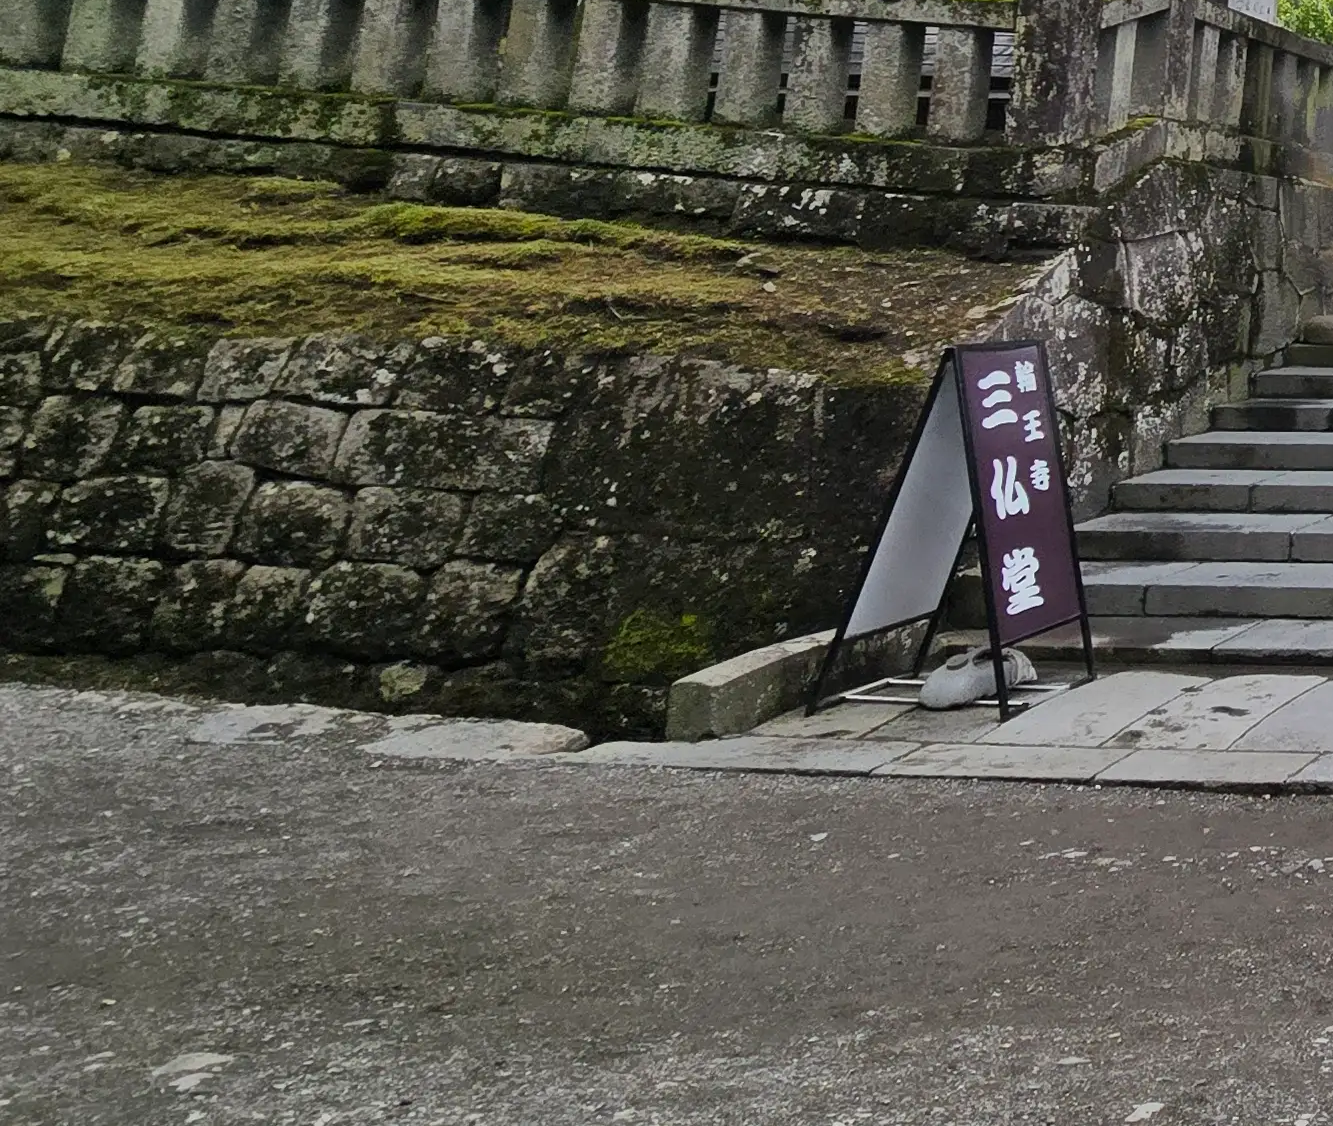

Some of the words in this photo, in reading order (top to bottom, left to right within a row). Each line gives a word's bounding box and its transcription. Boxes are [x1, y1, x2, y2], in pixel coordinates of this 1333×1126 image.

[978, 369, 1045, 616] 三仏堂
[1014, 360, 1050, 492] 輪王寺
